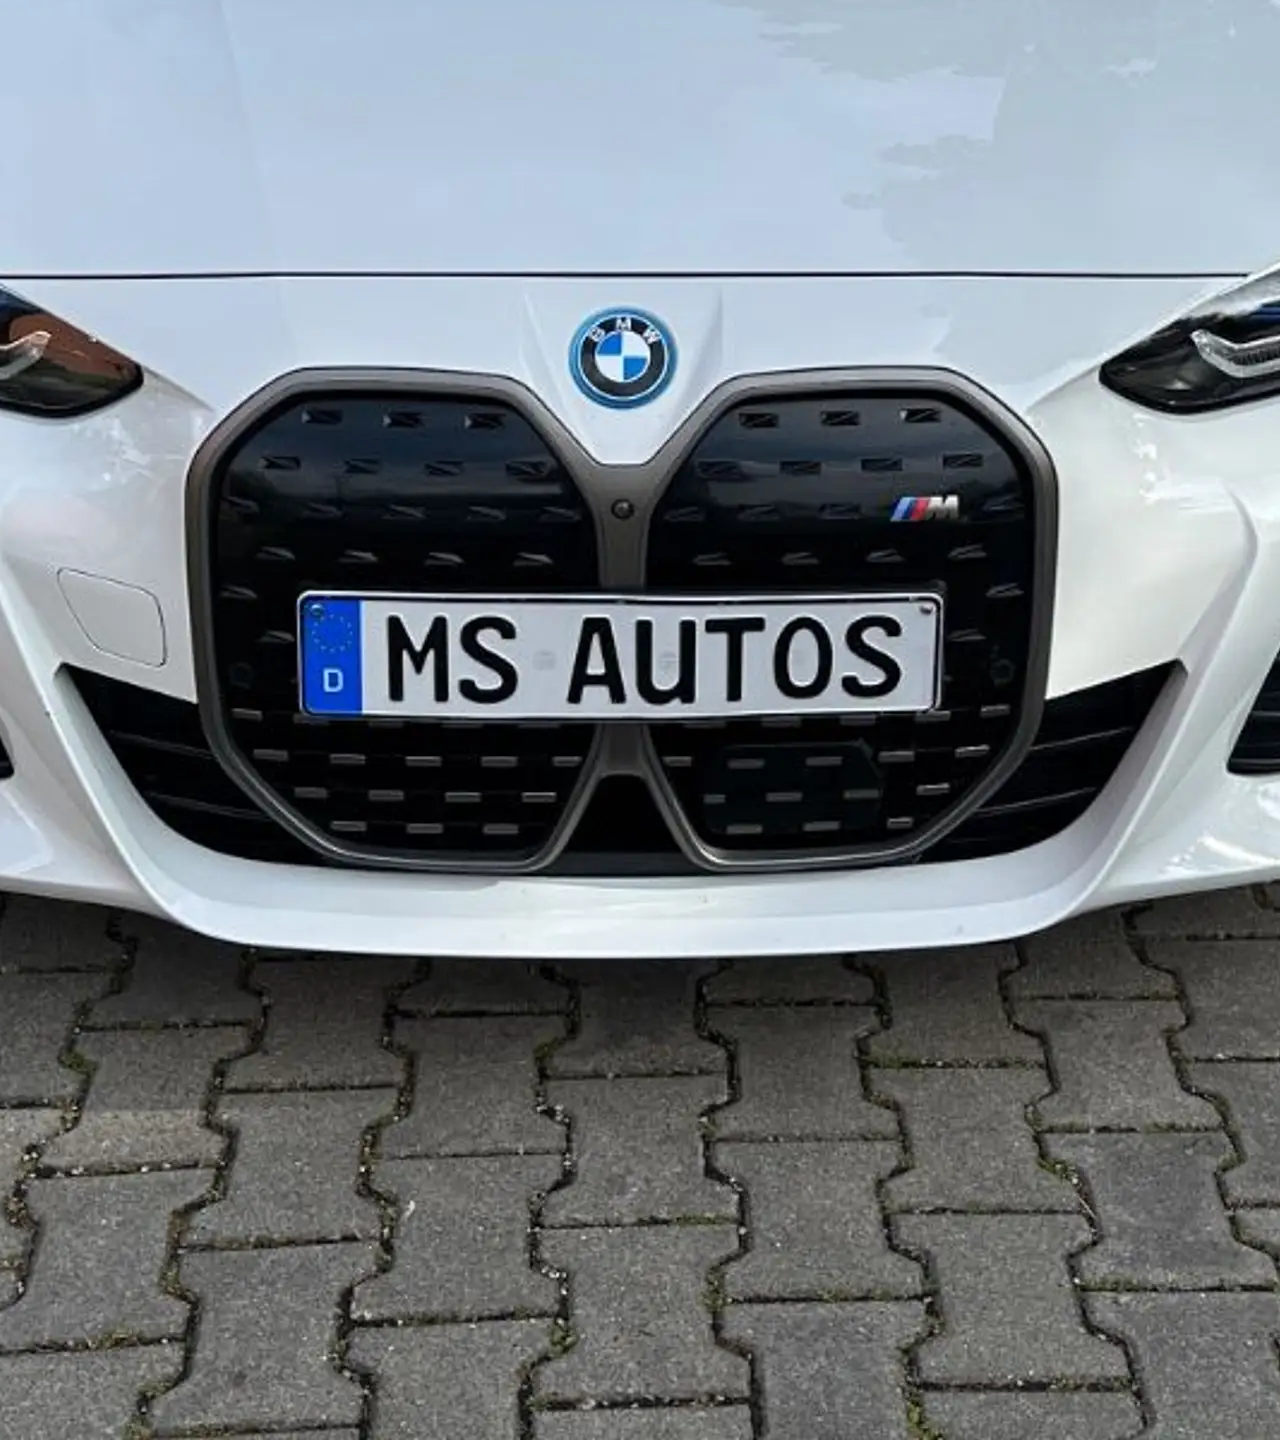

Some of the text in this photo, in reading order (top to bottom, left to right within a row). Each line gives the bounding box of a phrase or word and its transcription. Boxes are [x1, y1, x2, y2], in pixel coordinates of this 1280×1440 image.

[322, 667, 344, 693] D
[385, 615, 903, 706] MS AUTOS
